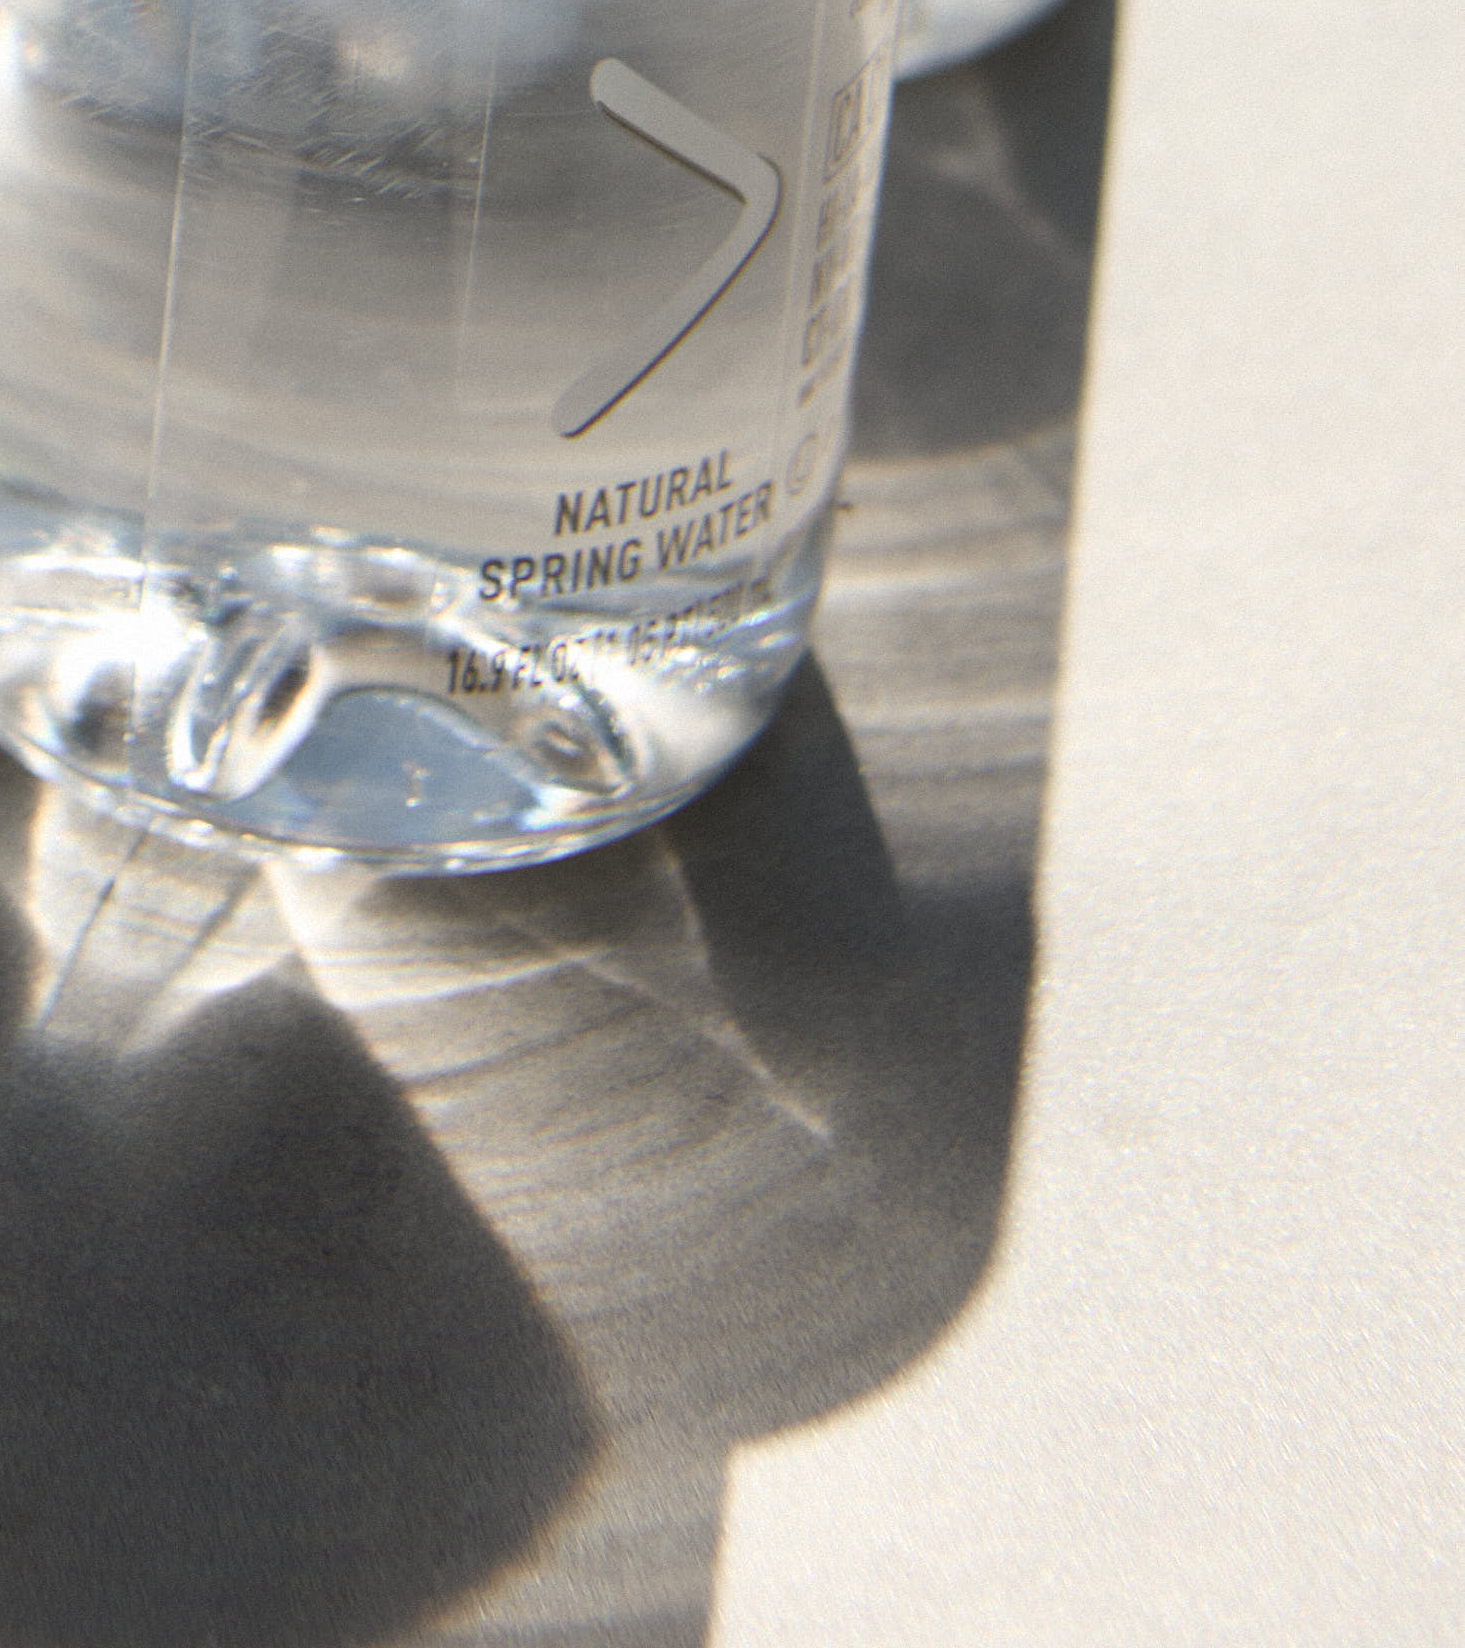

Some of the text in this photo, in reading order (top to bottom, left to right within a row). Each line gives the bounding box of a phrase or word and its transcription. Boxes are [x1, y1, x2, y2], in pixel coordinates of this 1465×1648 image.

[553, 447, 733, 537] NATURAL
[478, 479, 774, 602] SPRING WATER
[446, 647, 506, 696] 16.9
